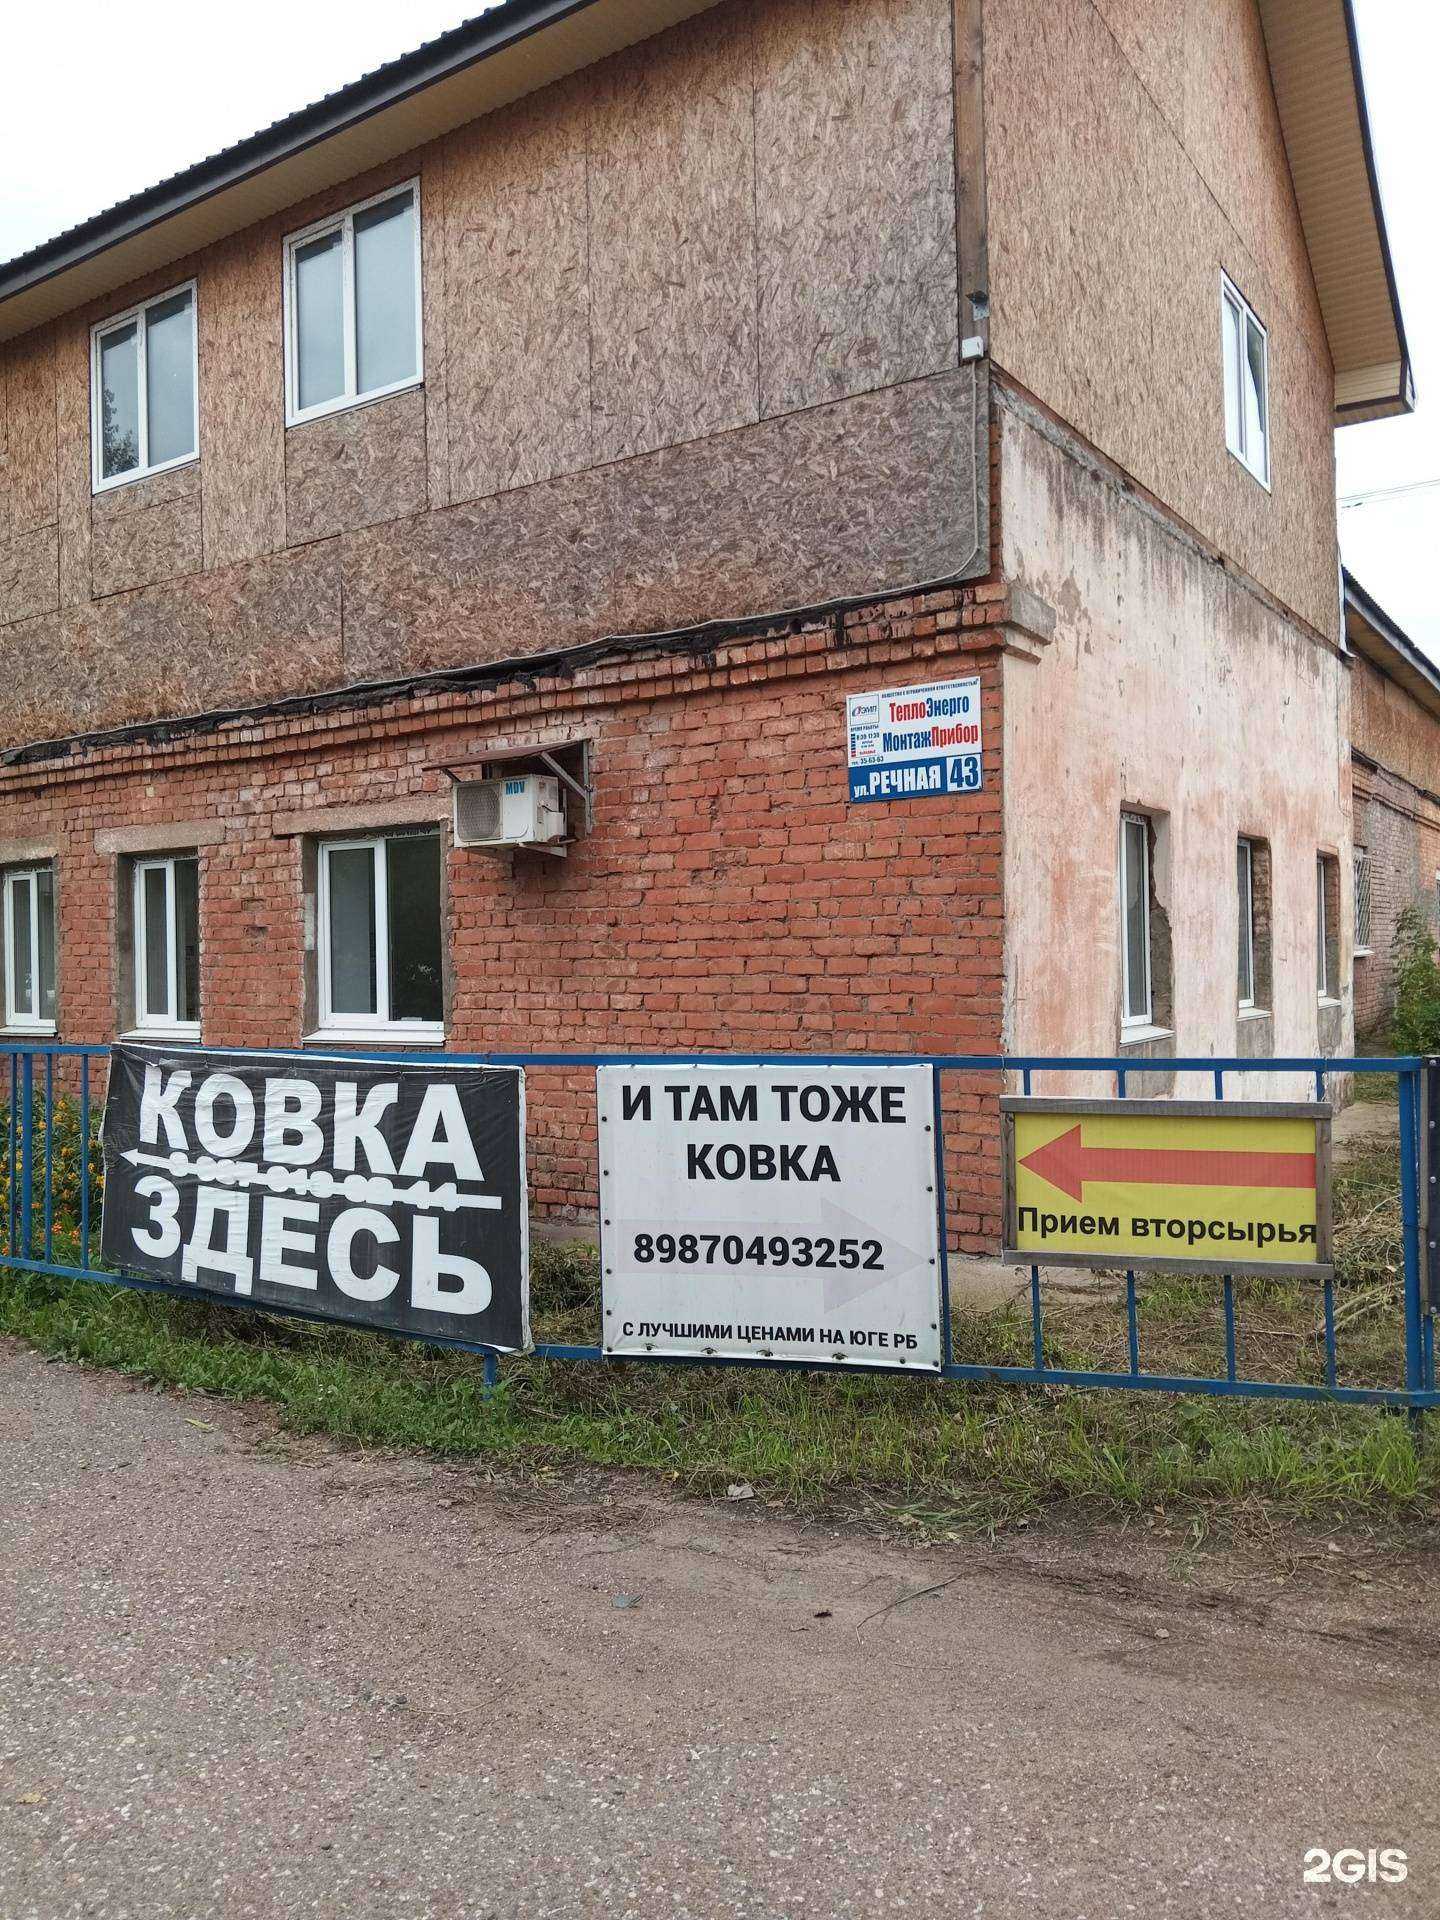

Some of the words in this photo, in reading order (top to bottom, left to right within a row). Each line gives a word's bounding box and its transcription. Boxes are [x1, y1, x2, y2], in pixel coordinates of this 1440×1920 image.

[889, 696, 970, 723] ТеплоЭнерго
[882, 723, 979, 753] МонтажПрибор
[506, 781, 525, 795] MDV
[869, 764, 941, 796] РЕЧНАЯ
[950, 756, 979, 788] 43
[139, 1063, 486, 1182] КОВКА
[622, 1085, 652, 1121] И
[664, 1085, 758, 1122] ТАМ
[771, 1085, 907, 1124] ТОЖЕ
[687, 1143, 842, 1182] КОВКА
[130, 1175, 493, 1315] ЗДЕСЬ
[1018, 1207, 1120, 1238] Прием
[1131, 1217, 1317, 1248] вторсырья
[634, 1233, 885, 1270] 89870493252
[622, 1322, 634, 1337] С
[638, 1322, 733, 1340] ЛУЧШИМИ
[737, 1325, 815, 1343] ЦЕНАМИ
[820, 1329, 844, 1345] НА
[850, 1330, 889, 1348] ЮГЕ
[894, 1334, 918, 1350] РБ
